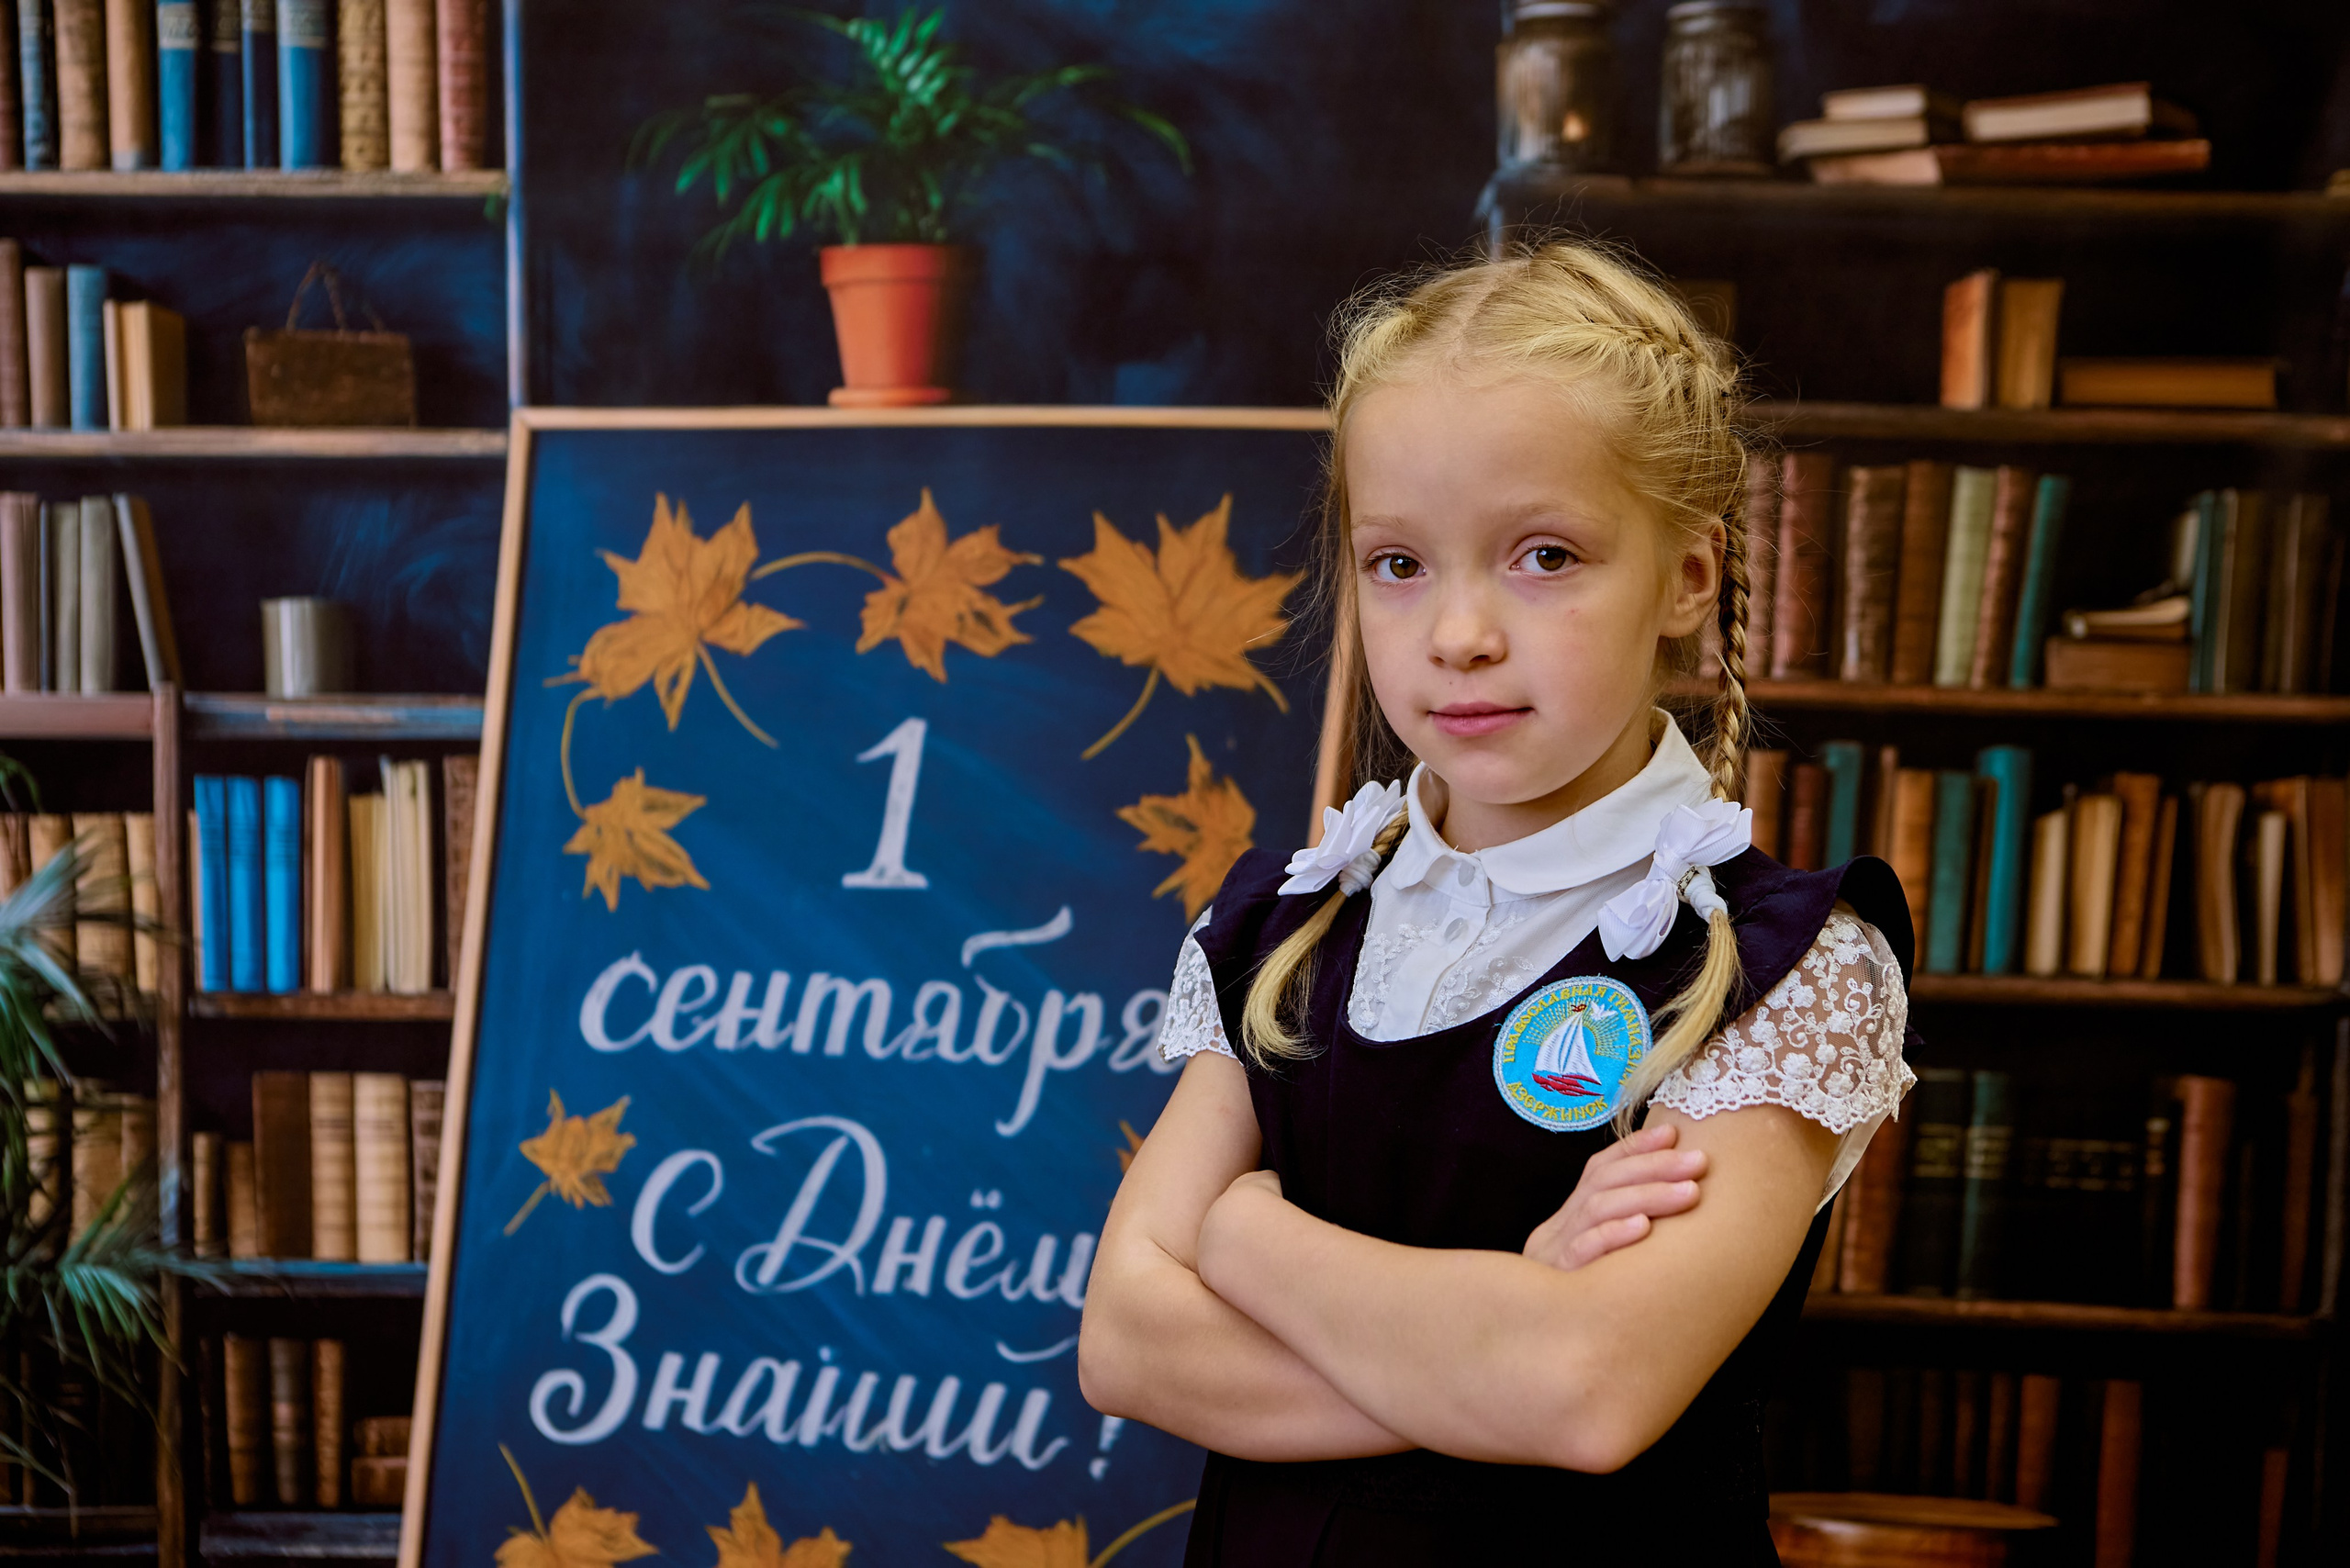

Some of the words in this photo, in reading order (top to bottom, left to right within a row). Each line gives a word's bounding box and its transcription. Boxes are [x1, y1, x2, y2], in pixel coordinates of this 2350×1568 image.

[841, 717, 928, 890] 1
[579, 905, 1186, 1137] сентября
[733, 1114, 1096, 1309] Днём
